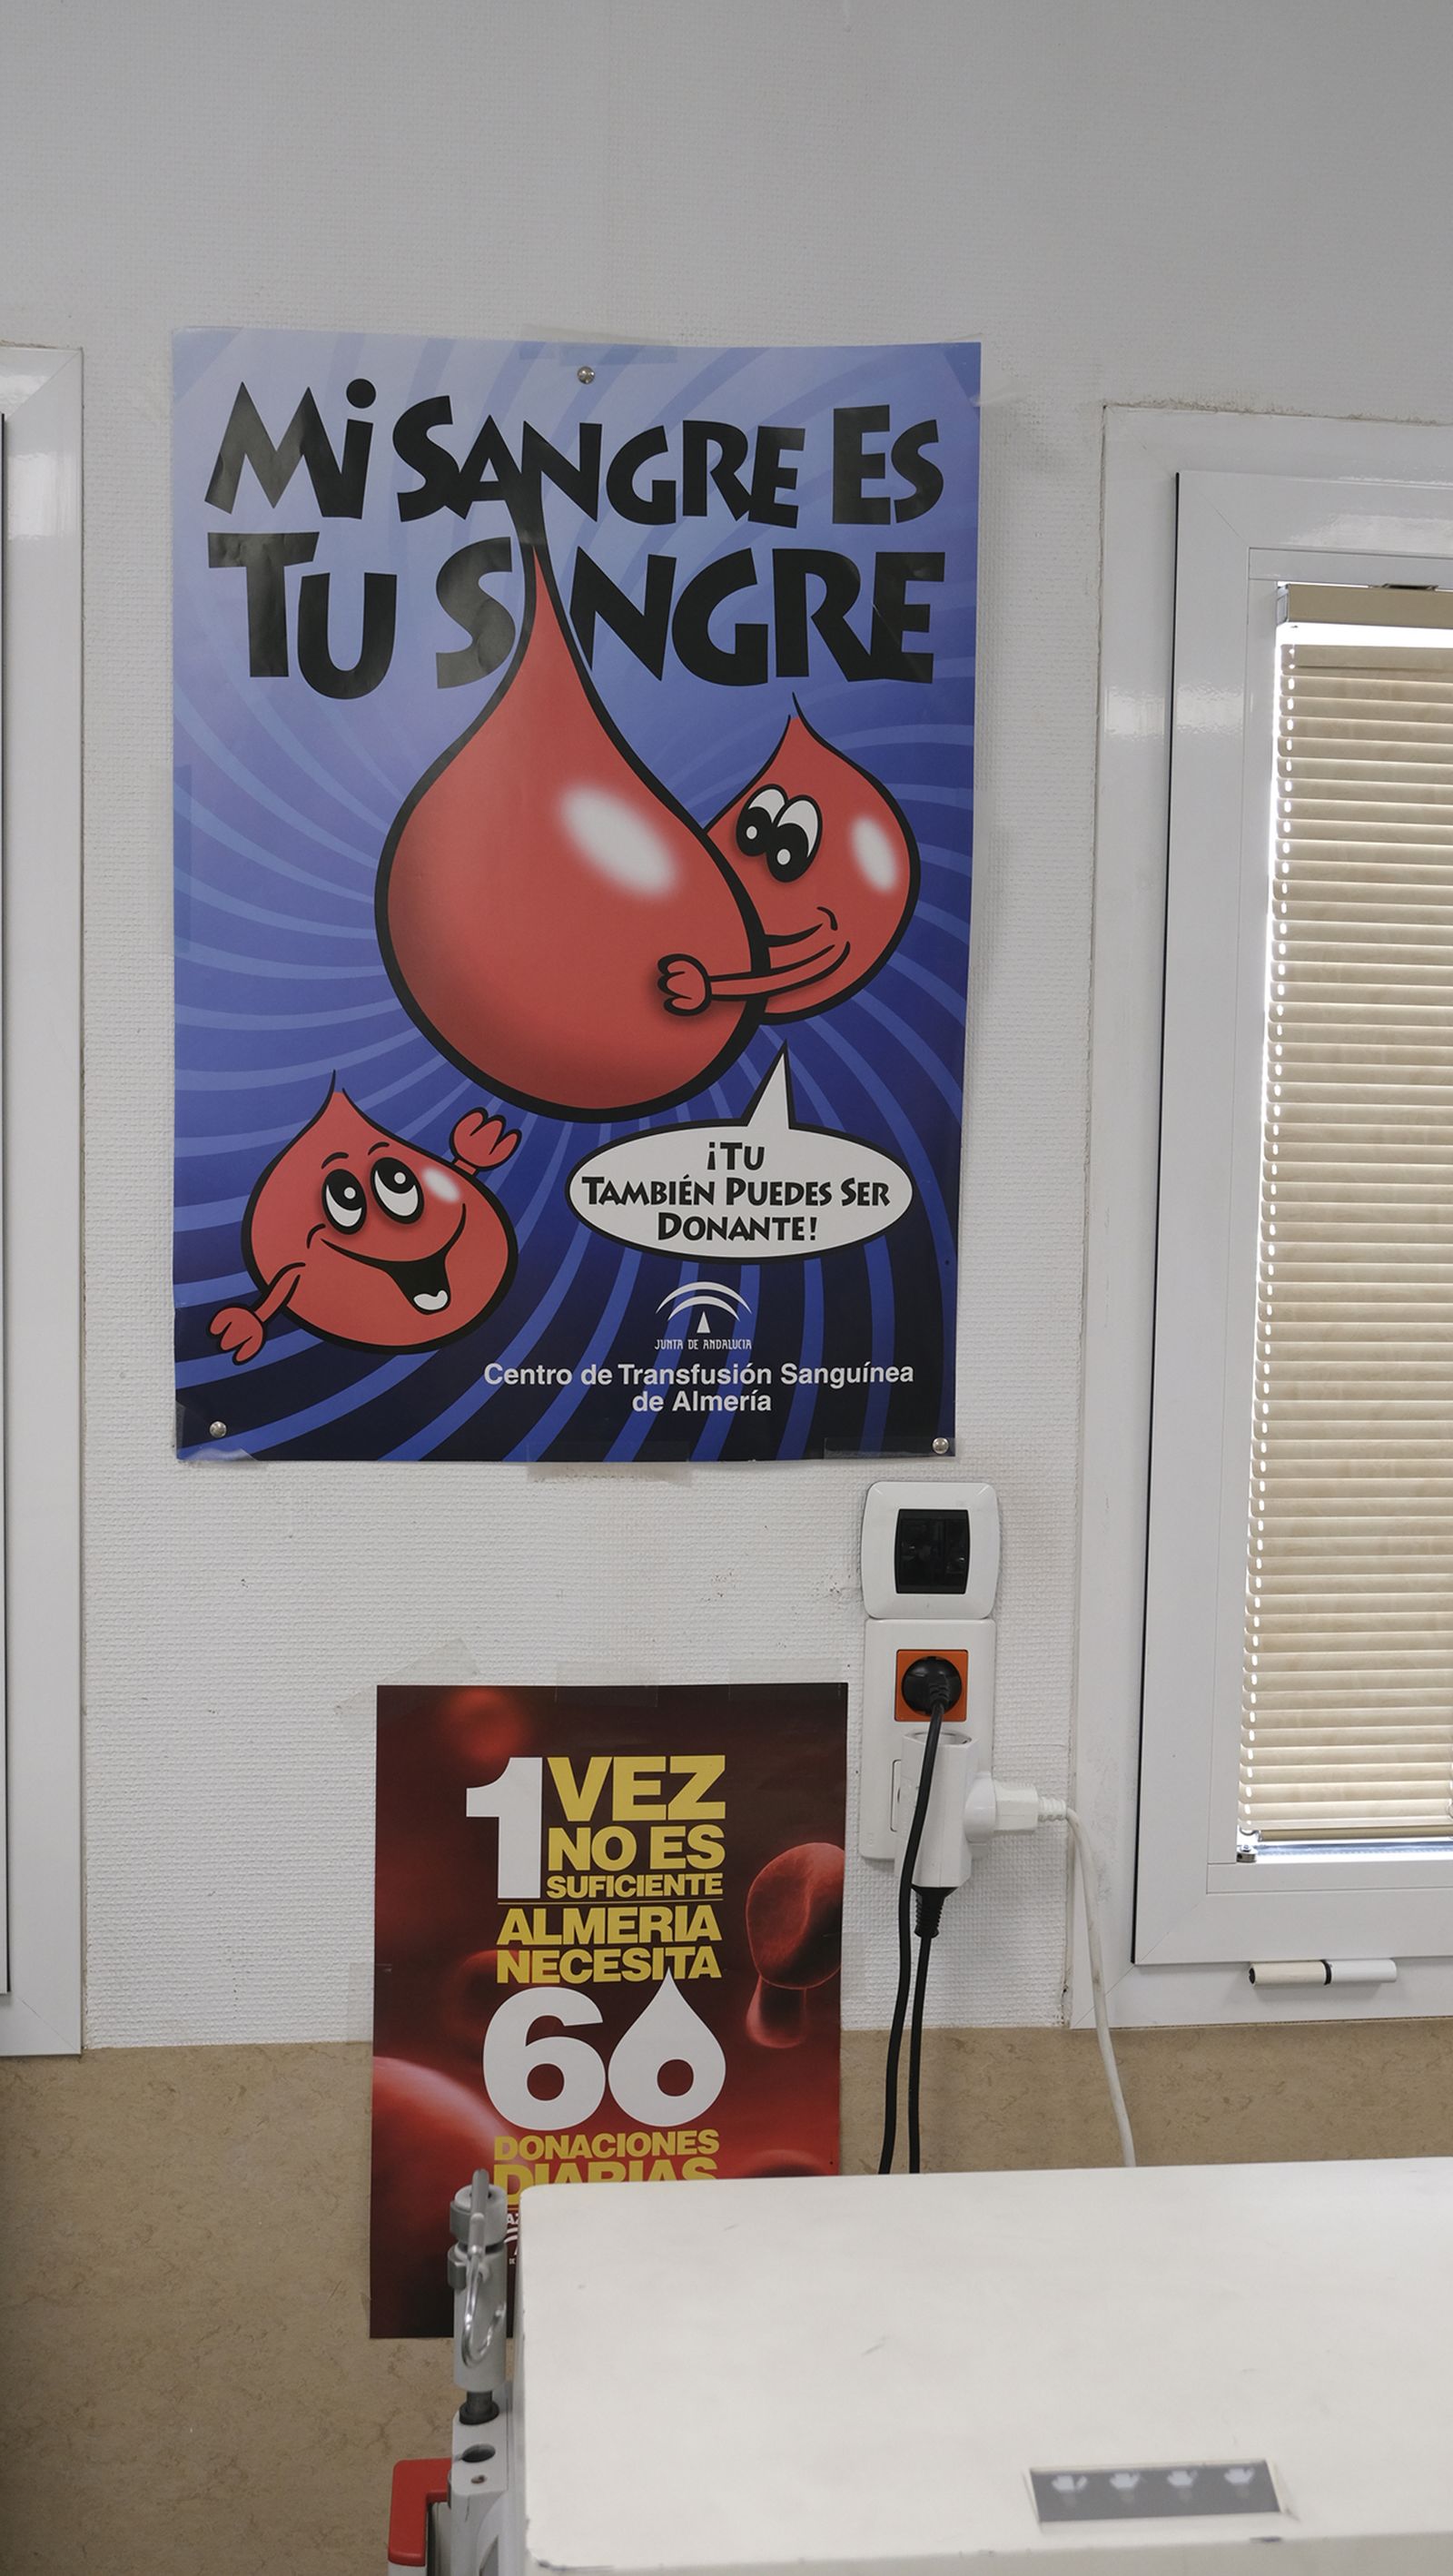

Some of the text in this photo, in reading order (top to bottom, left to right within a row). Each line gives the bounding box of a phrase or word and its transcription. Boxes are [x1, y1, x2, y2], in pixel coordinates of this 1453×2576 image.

[391, 394, 806, 529] SANGRE
[206, 531, 398, 700] TU
[581, 1174, 891, 1207] TAMBIÉN PUEDES SER
[657, 1212, 817, 1241] DONANTE!
[654, 1338, 753, 1350] JUNTA DE ANDALUCIA
[484, 1362, 914, 1389] Centro de Transfusión Sanguínea
[632, 1390, 772, 1412] de Almería
[466, 1754, 726, 1900] 1 VEZ
[548, 1824, 726, 1871] NO ES
[546, 1872, 724, 1899] SUFICIENTE
[497, 1905, 722, 1946] ALMERIA
[497, 1946, 722, 1984] NECESITA
[482, 1967, 726, 2131] 60
[493, 2128, 719, 2161] DONACIONES
